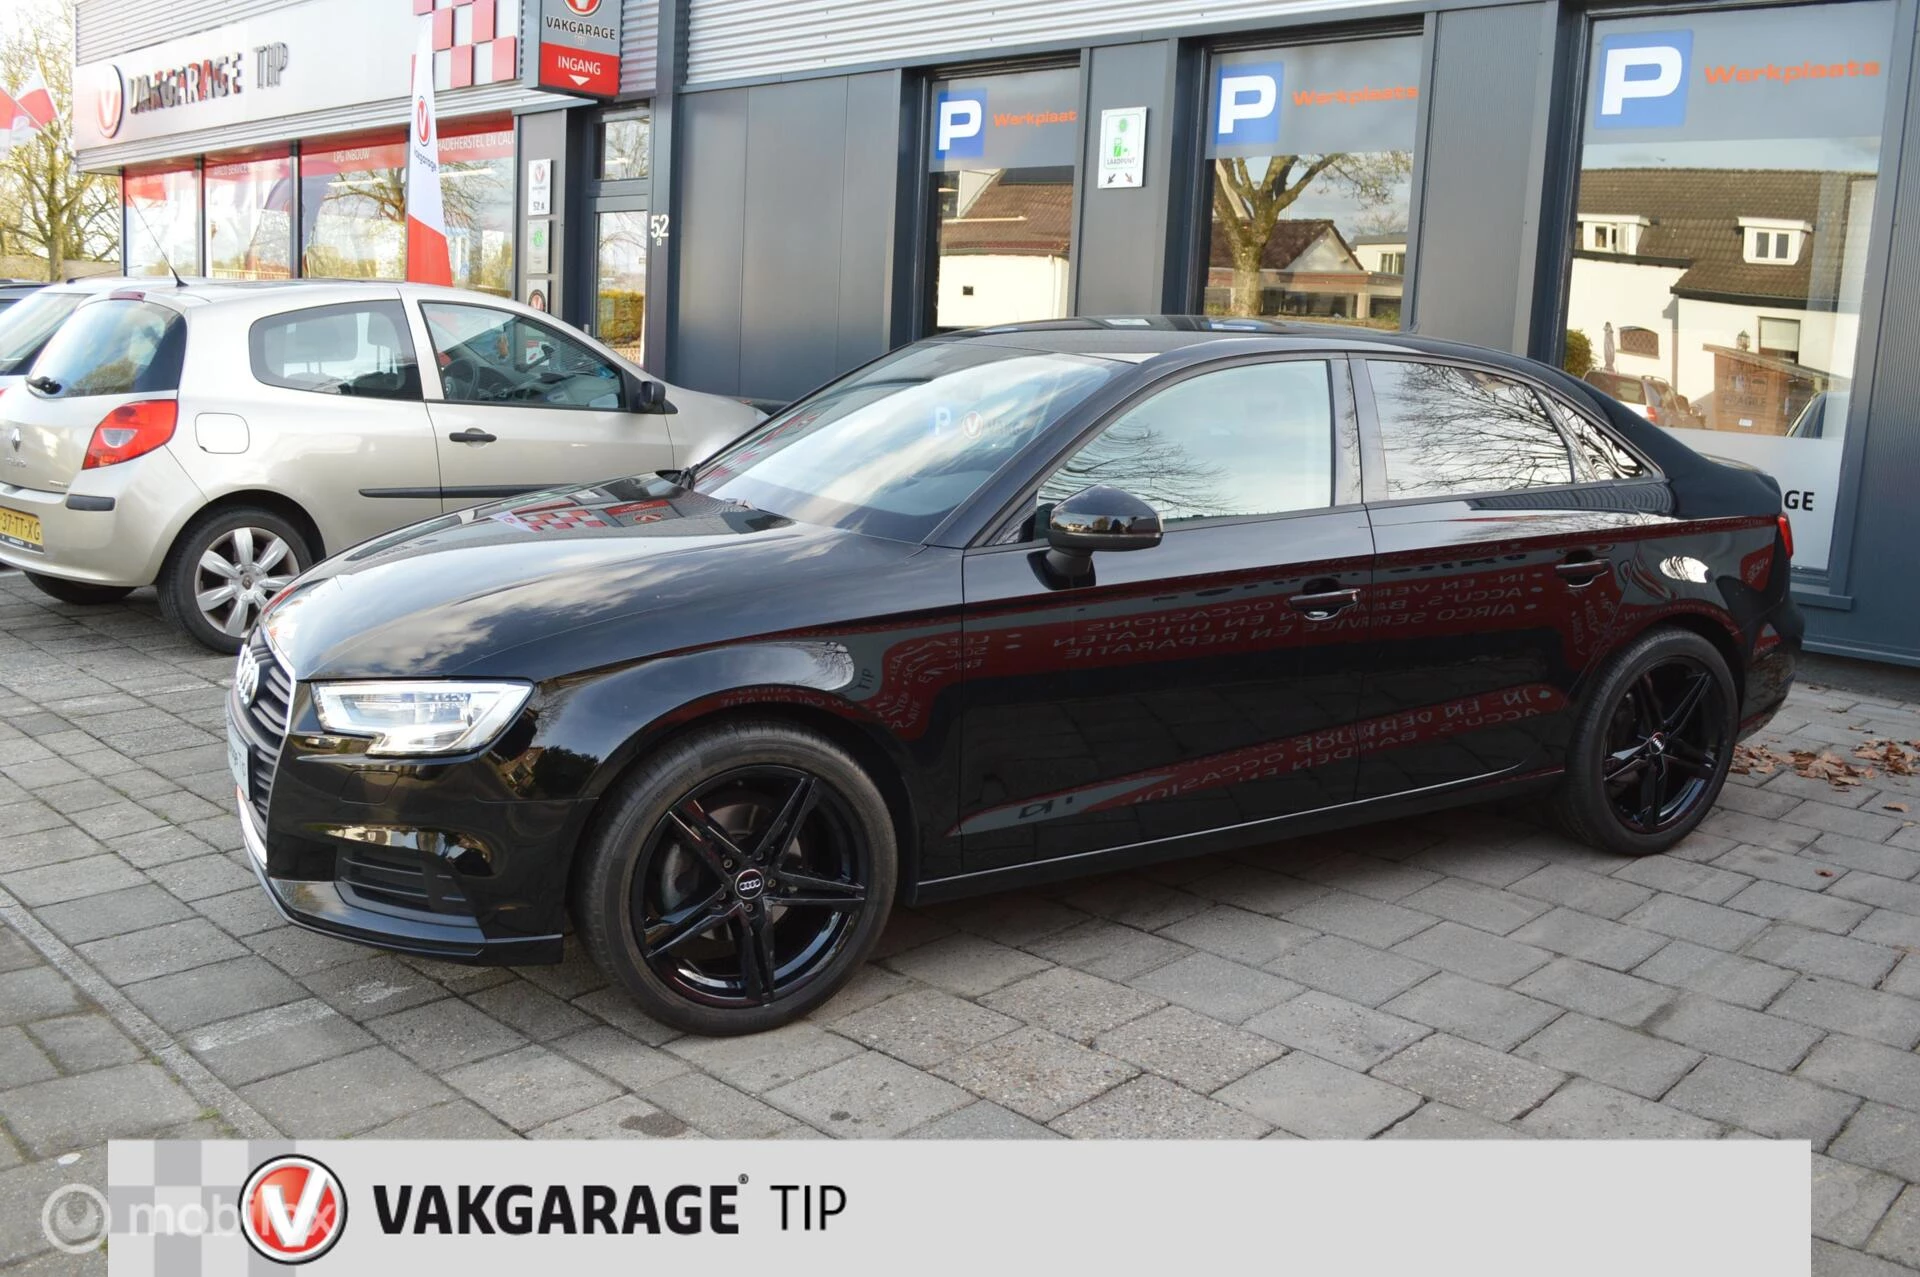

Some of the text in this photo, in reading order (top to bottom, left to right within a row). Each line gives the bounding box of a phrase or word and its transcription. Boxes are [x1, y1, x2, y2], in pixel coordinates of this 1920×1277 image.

[546, 16, 616, 40] VAKGARAGE
[129, 42, 288, 114] VAKGARAGE TIP
[558, 56, 601, 75] INGANG
[1601, 46, 1881, 115] P Werkplaats
[1219, 75, 1419, 134] P Werkplaats
[938, 100, 982, 150] P
[651, 214, 670, 238] 52
[1784, 490, 1815, 511] GE
